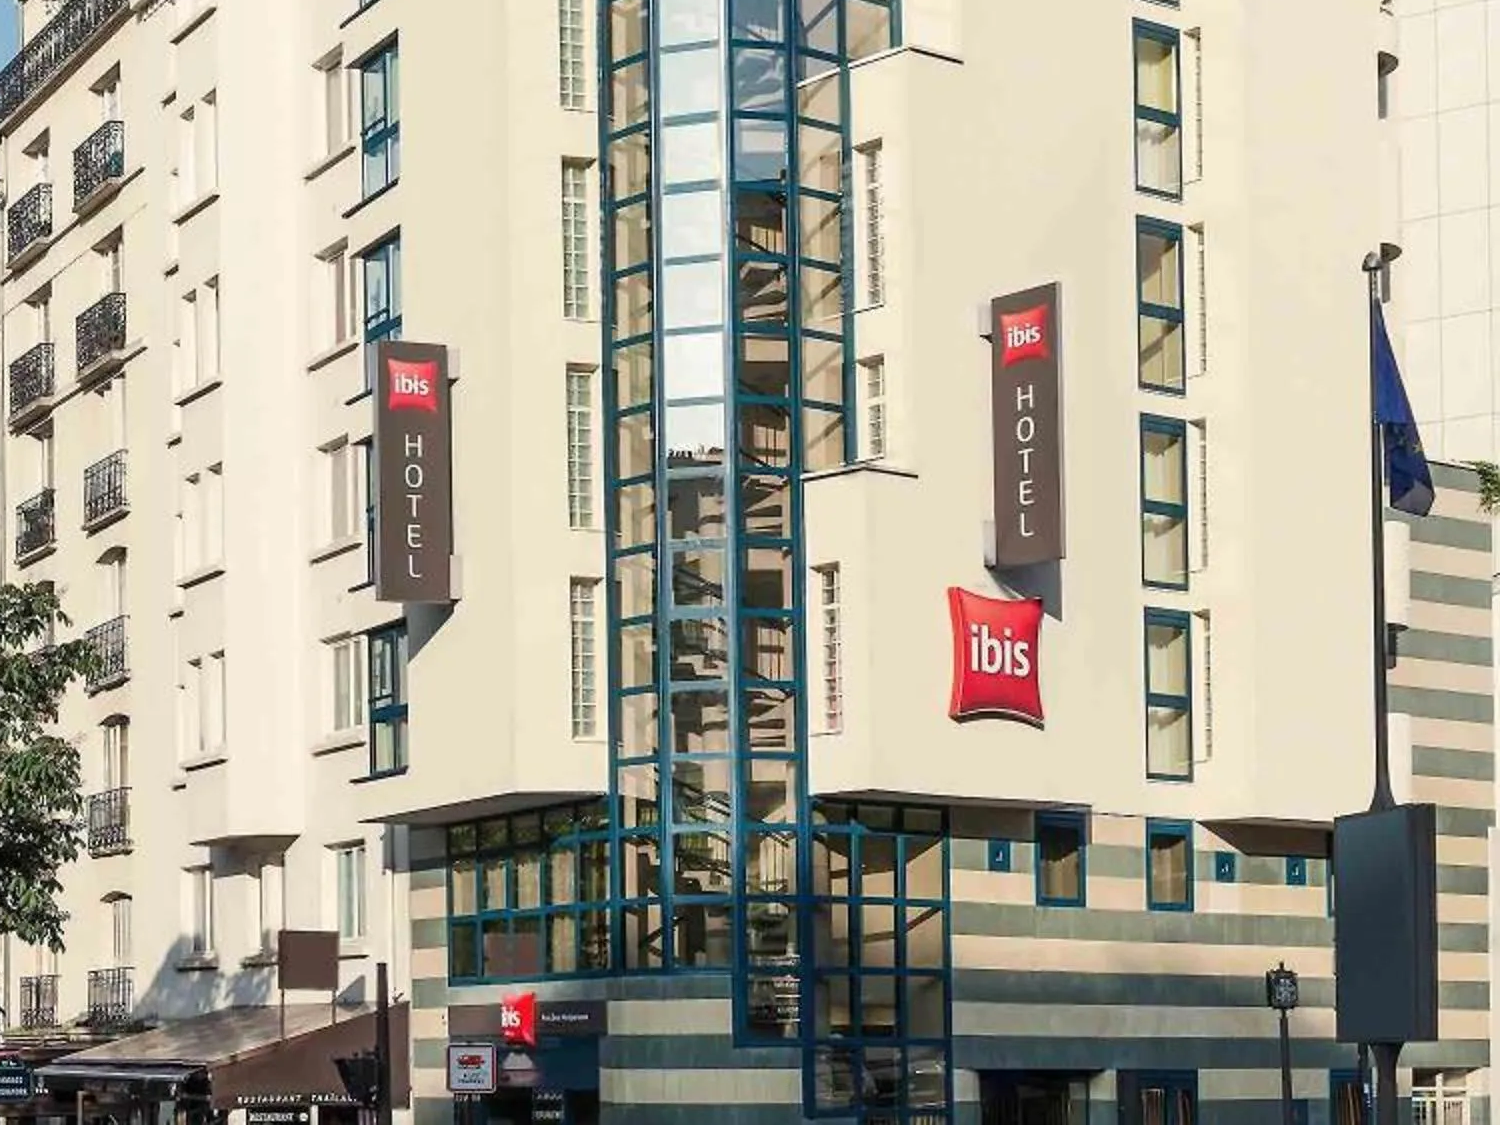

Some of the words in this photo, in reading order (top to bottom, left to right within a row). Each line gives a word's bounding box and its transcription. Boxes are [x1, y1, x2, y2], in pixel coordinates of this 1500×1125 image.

[1007, 325, 1041, 348] ibis
[394, 373, 429, 396] ibis
[1016, 384, 1035, 537] HOTEL
[405, 434, 423, 579] HOTEL
[970, 623, 1031, 677] ibis
